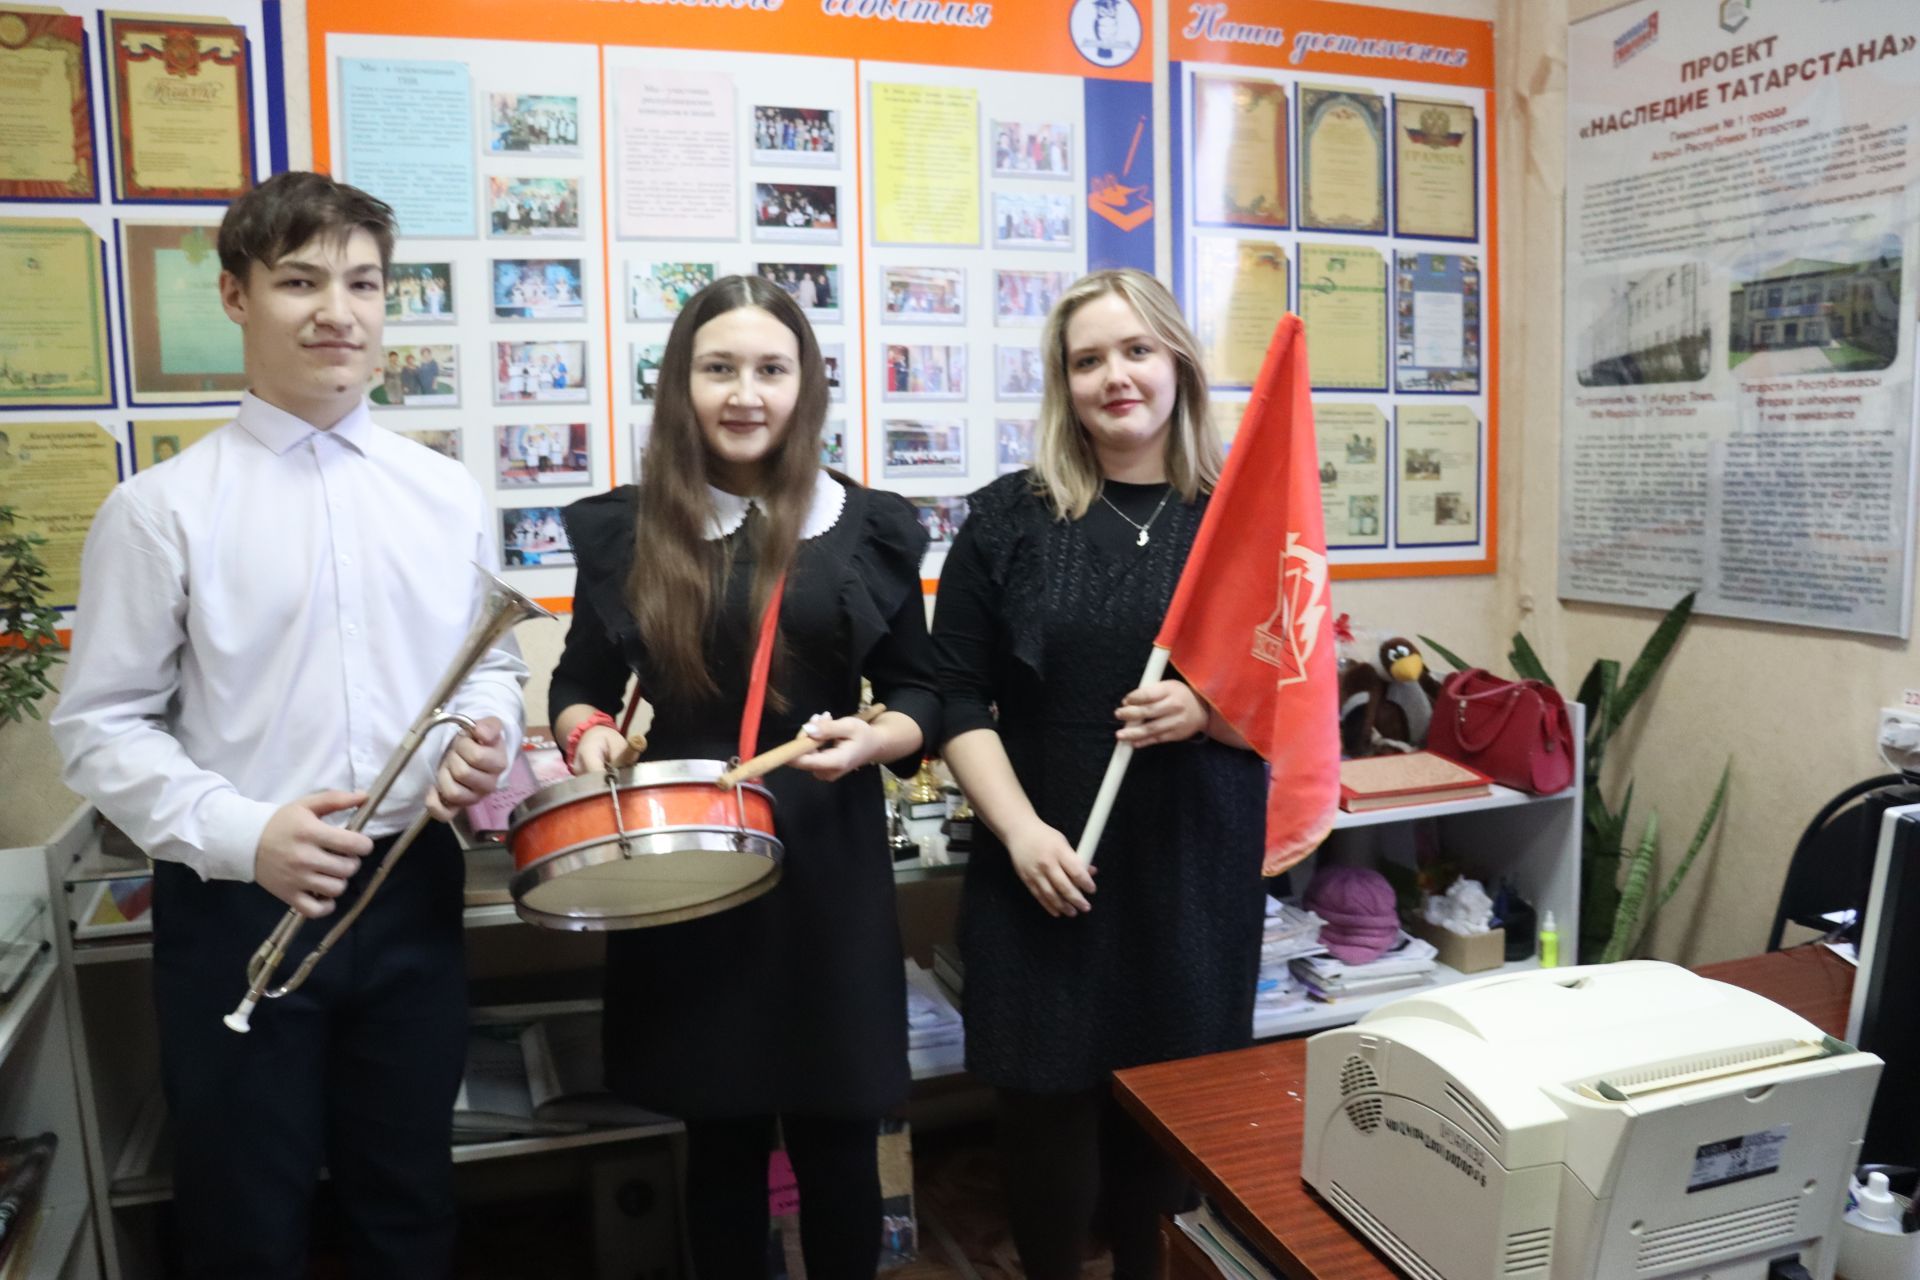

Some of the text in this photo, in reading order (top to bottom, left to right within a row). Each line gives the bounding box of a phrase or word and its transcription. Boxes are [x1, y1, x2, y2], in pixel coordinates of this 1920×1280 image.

[1184, 2, 1468, 67] Наши достижения
[1681, 35, 1779, 83] ПРОЕКТ
[1580, 34, 1917, 140] «НАСЛЕДИЕ ТАТАРСТАНА»
